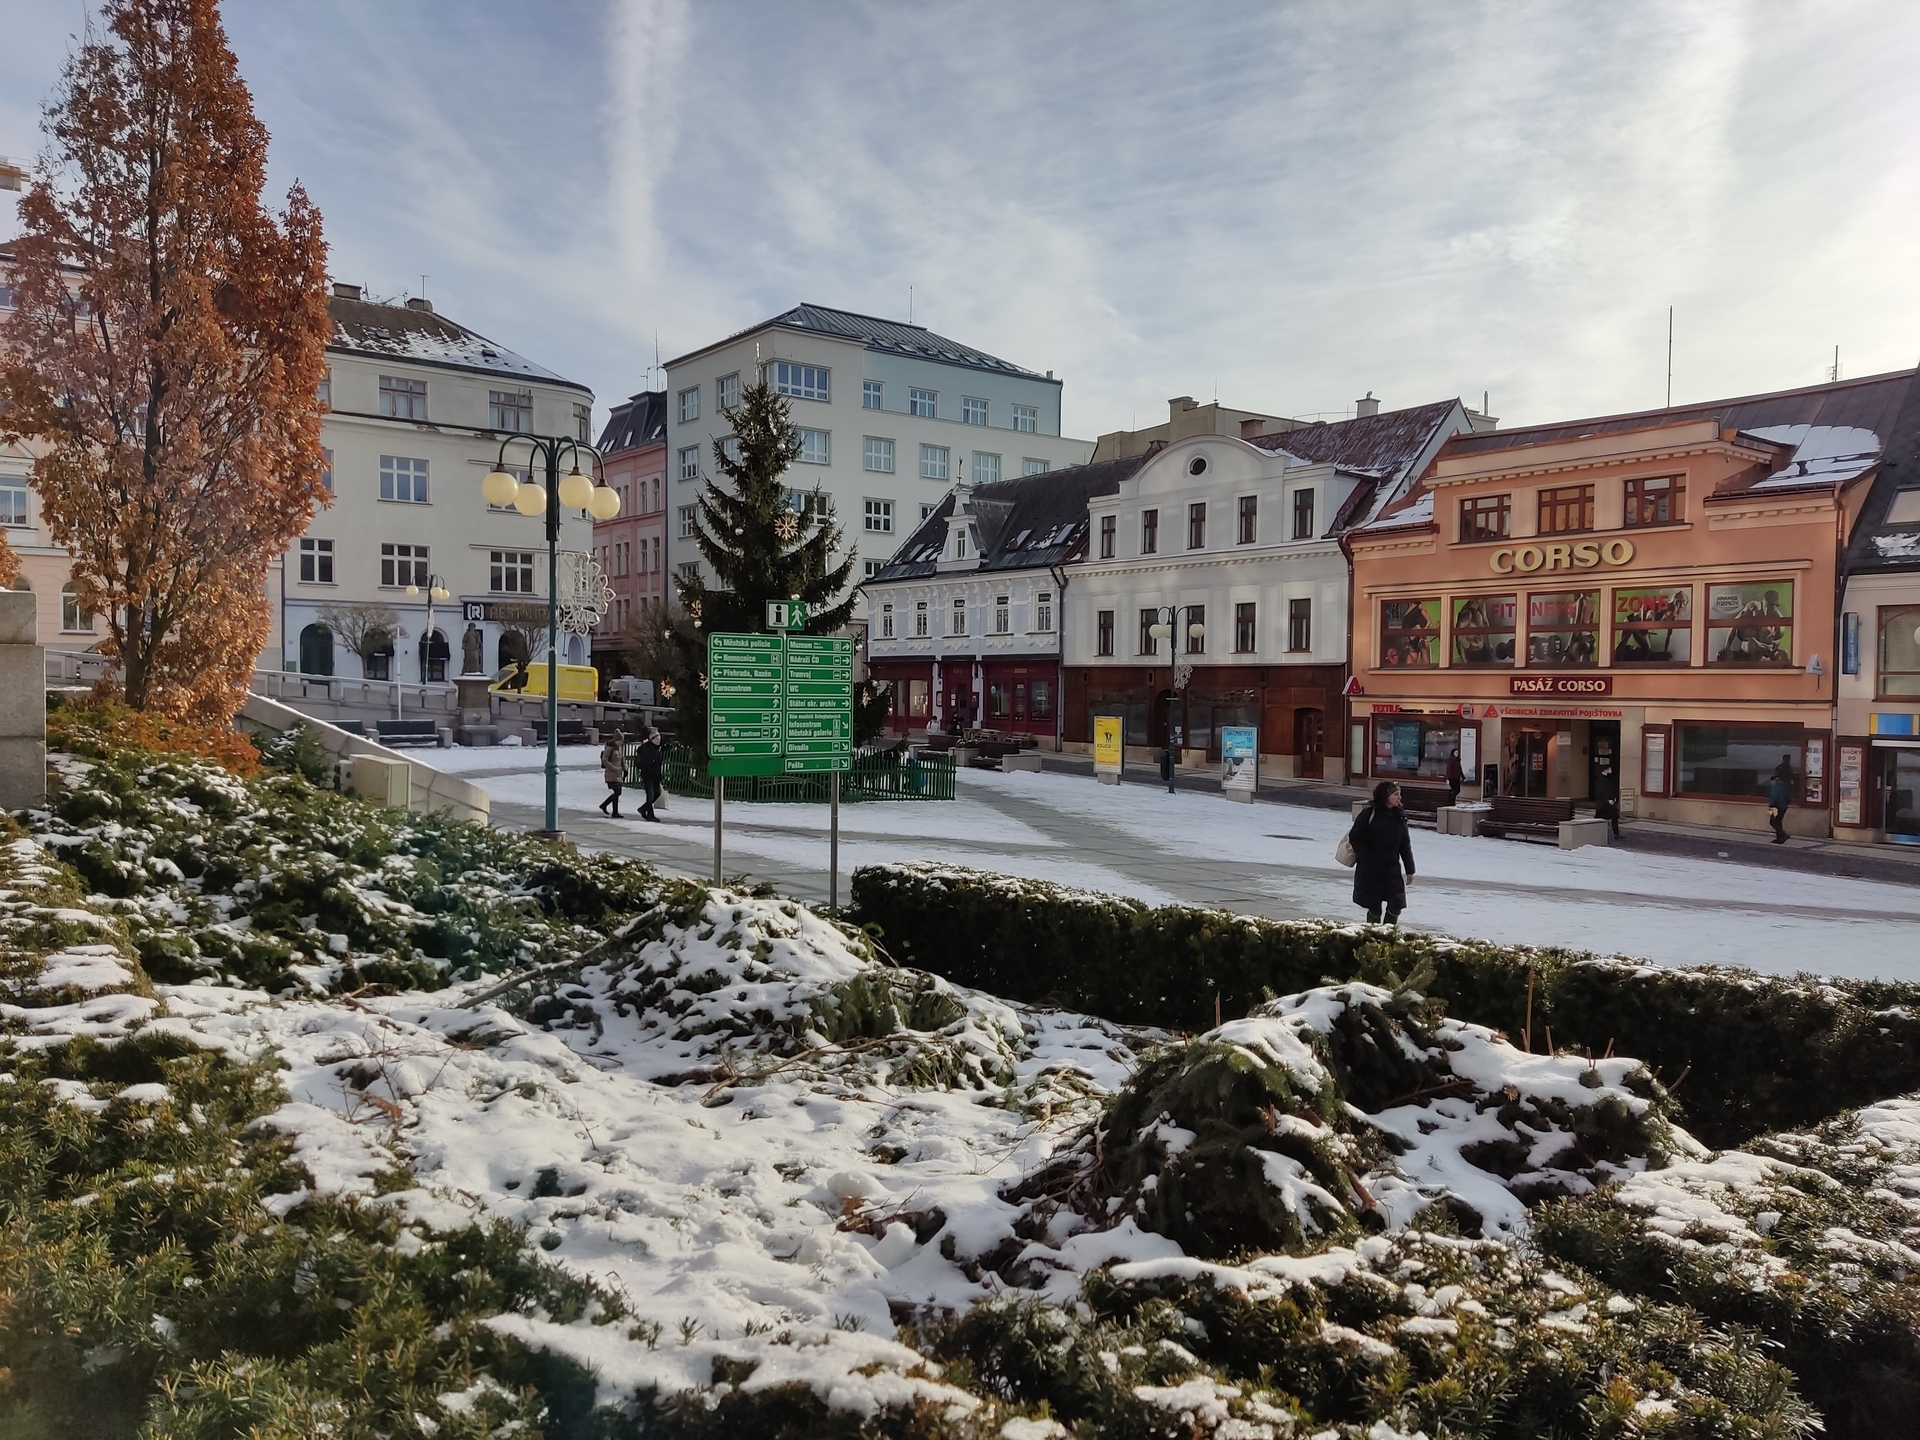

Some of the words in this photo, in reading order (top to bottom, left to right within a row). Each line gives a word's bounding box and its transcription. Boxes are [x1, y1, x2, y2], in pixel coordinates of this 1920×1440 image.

[1489, 538, 1634, 574] CORSO
[1617, 594, 1669, 612] ZONE
[750, 640, 771, 648] policie
[723, 653, 757, 662] Nemocnice
[811, 654, 820, 664] ČD
[790, 670, 811, 679] Tramvaj
[714, 684, 752, 692] Eurocentrum
[789, 685, 799, 693] WC
[1513, 677, 1554, 692] PASÁŽ
[1557, 680, 1606, 692] CORSO
[789, 699, 806, 707] Státní
[1500, 706, 1538, 716] VŠEOBECNÁ
[1539, 708, 1578, 717] ZDRAVOTNÍ
[1578, 708, 1623, 718] POJIŠŤOVNA
[714, 714, 726, 722] Bus
[788, 720, 822, 728] Infocentrum
[730, 728, 740, 737] ČD
[788, 728, 812, 737] Městská
[813, 729, 832, 737] galerie
[788, 743, 809, 751] Divadlo
[1394, 739, 1404, 747] 75
[714, 744, 735, 753] Policie
[787, 761, 804, 769] Pošta
